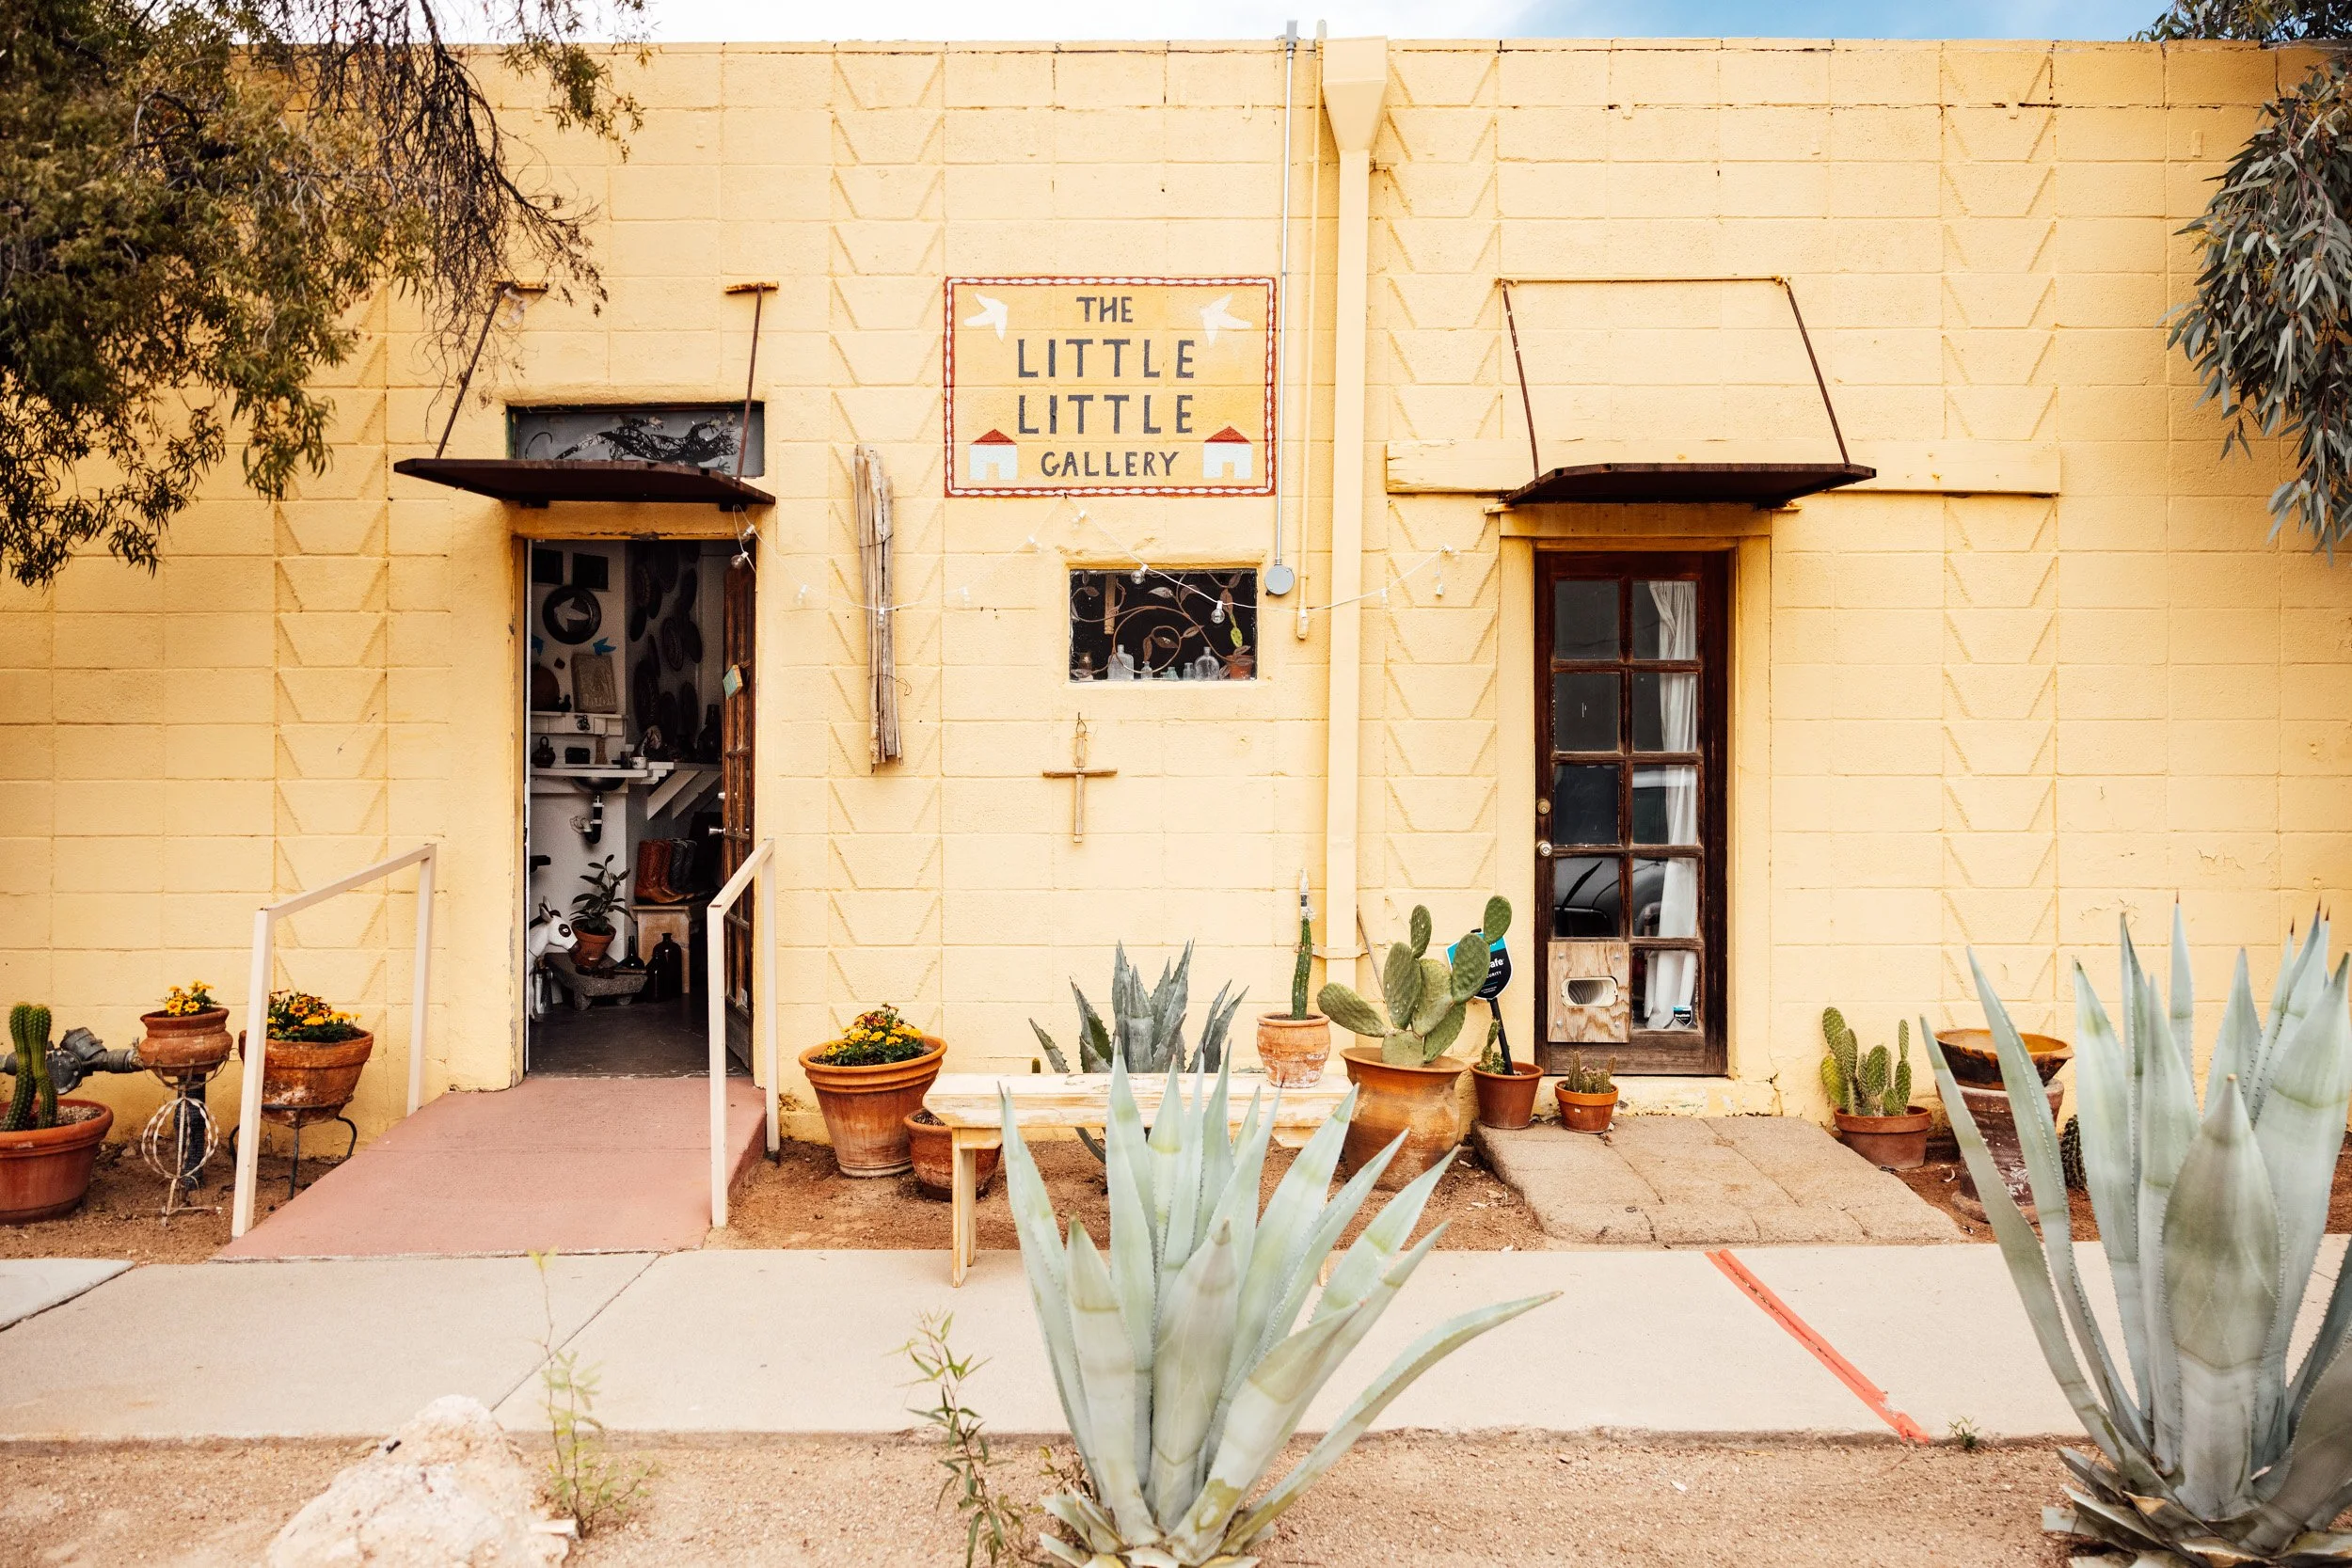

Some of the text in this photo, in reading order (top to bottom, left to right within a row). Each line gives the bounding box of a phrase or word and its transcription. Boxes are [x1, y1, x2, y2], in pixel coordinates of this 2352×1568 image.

[1076, 296, 1133, 323] THE
[1018, 339, 1195, 378] LITTLE
[1018, 395, 1193, 435] LITTLE
[1041, 451, 1180, 477] GALLERY
[1489, 958, 1503, 969] afe
